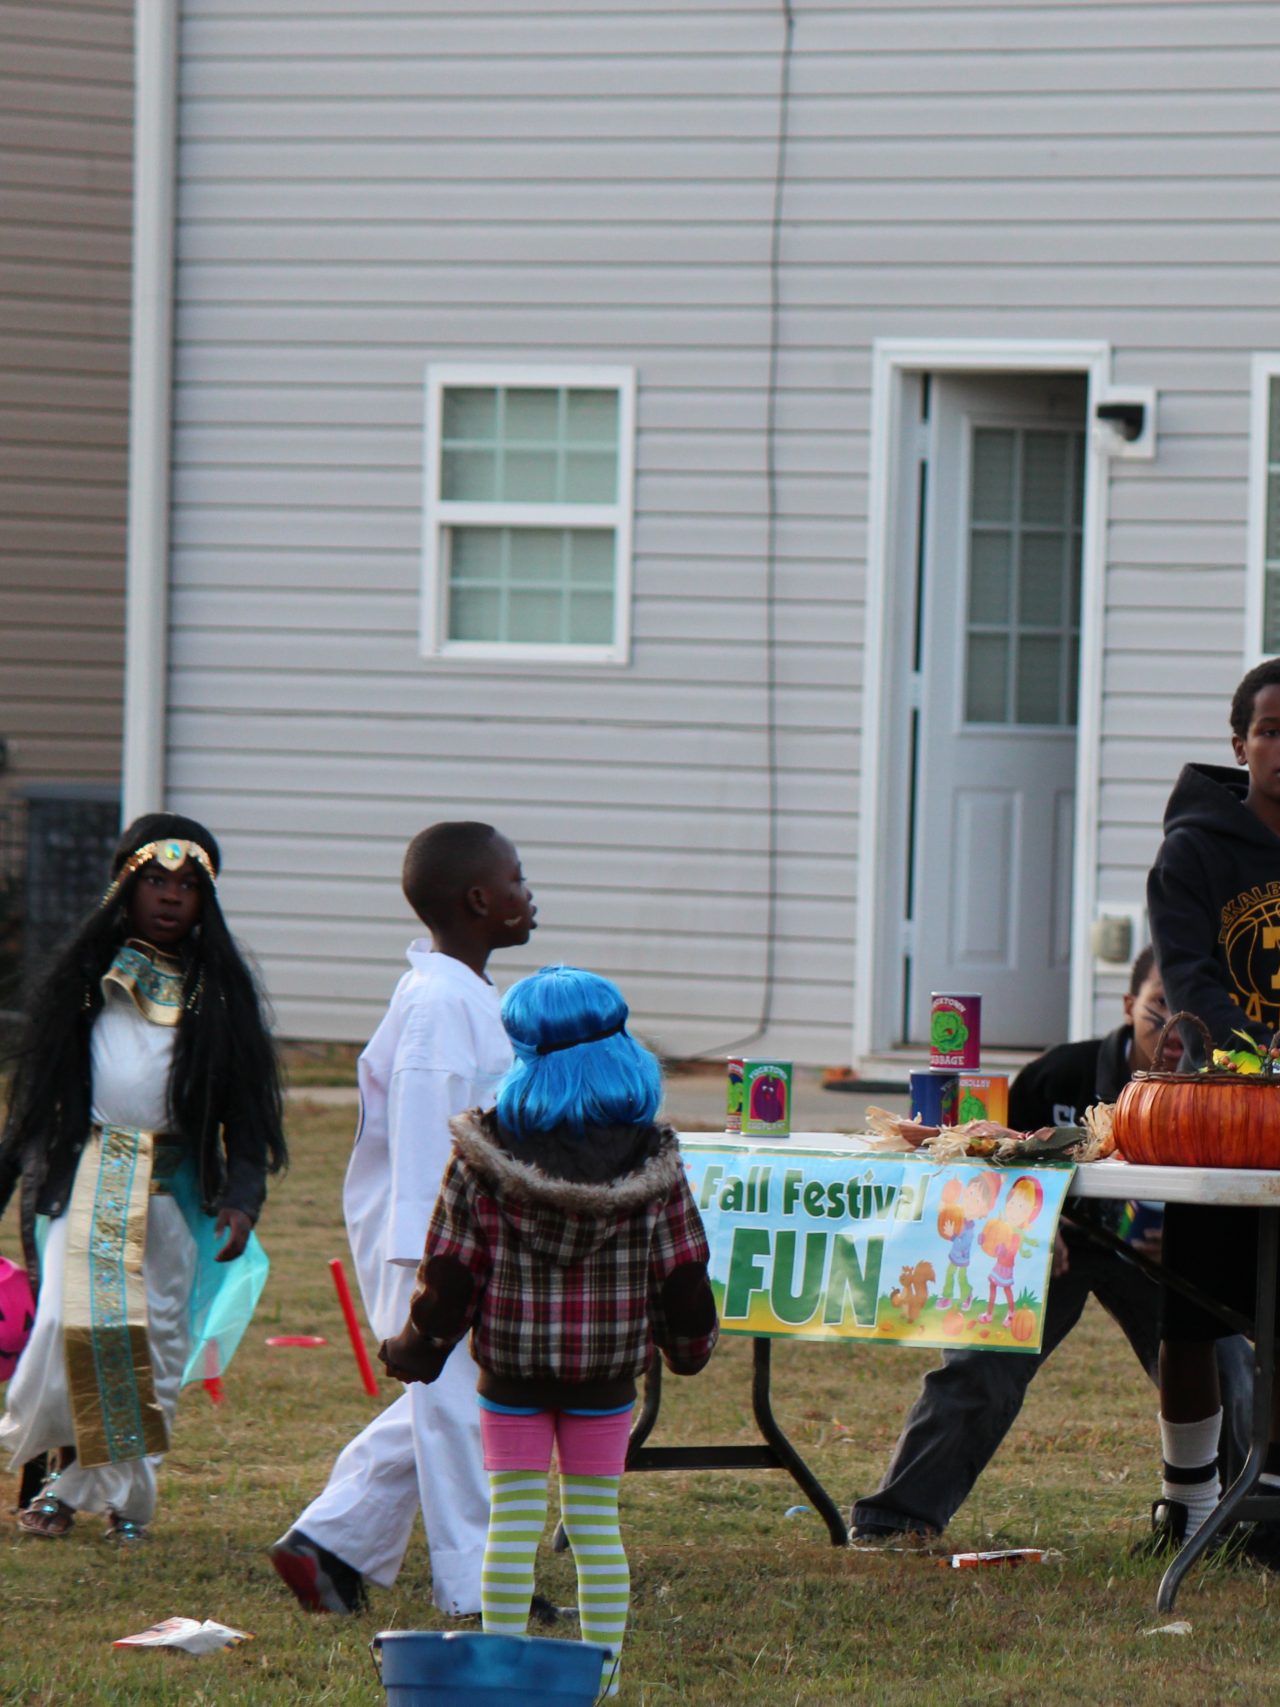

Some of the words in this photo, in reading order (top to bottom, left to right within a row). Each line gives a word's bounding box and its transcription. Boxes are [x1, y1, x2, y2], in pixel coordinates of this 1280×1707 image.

[700, 1164, 773, 1215] Fall
[782, 1167, 932, 1223] Festival
[722, 1227, 886, 1328] FUN
